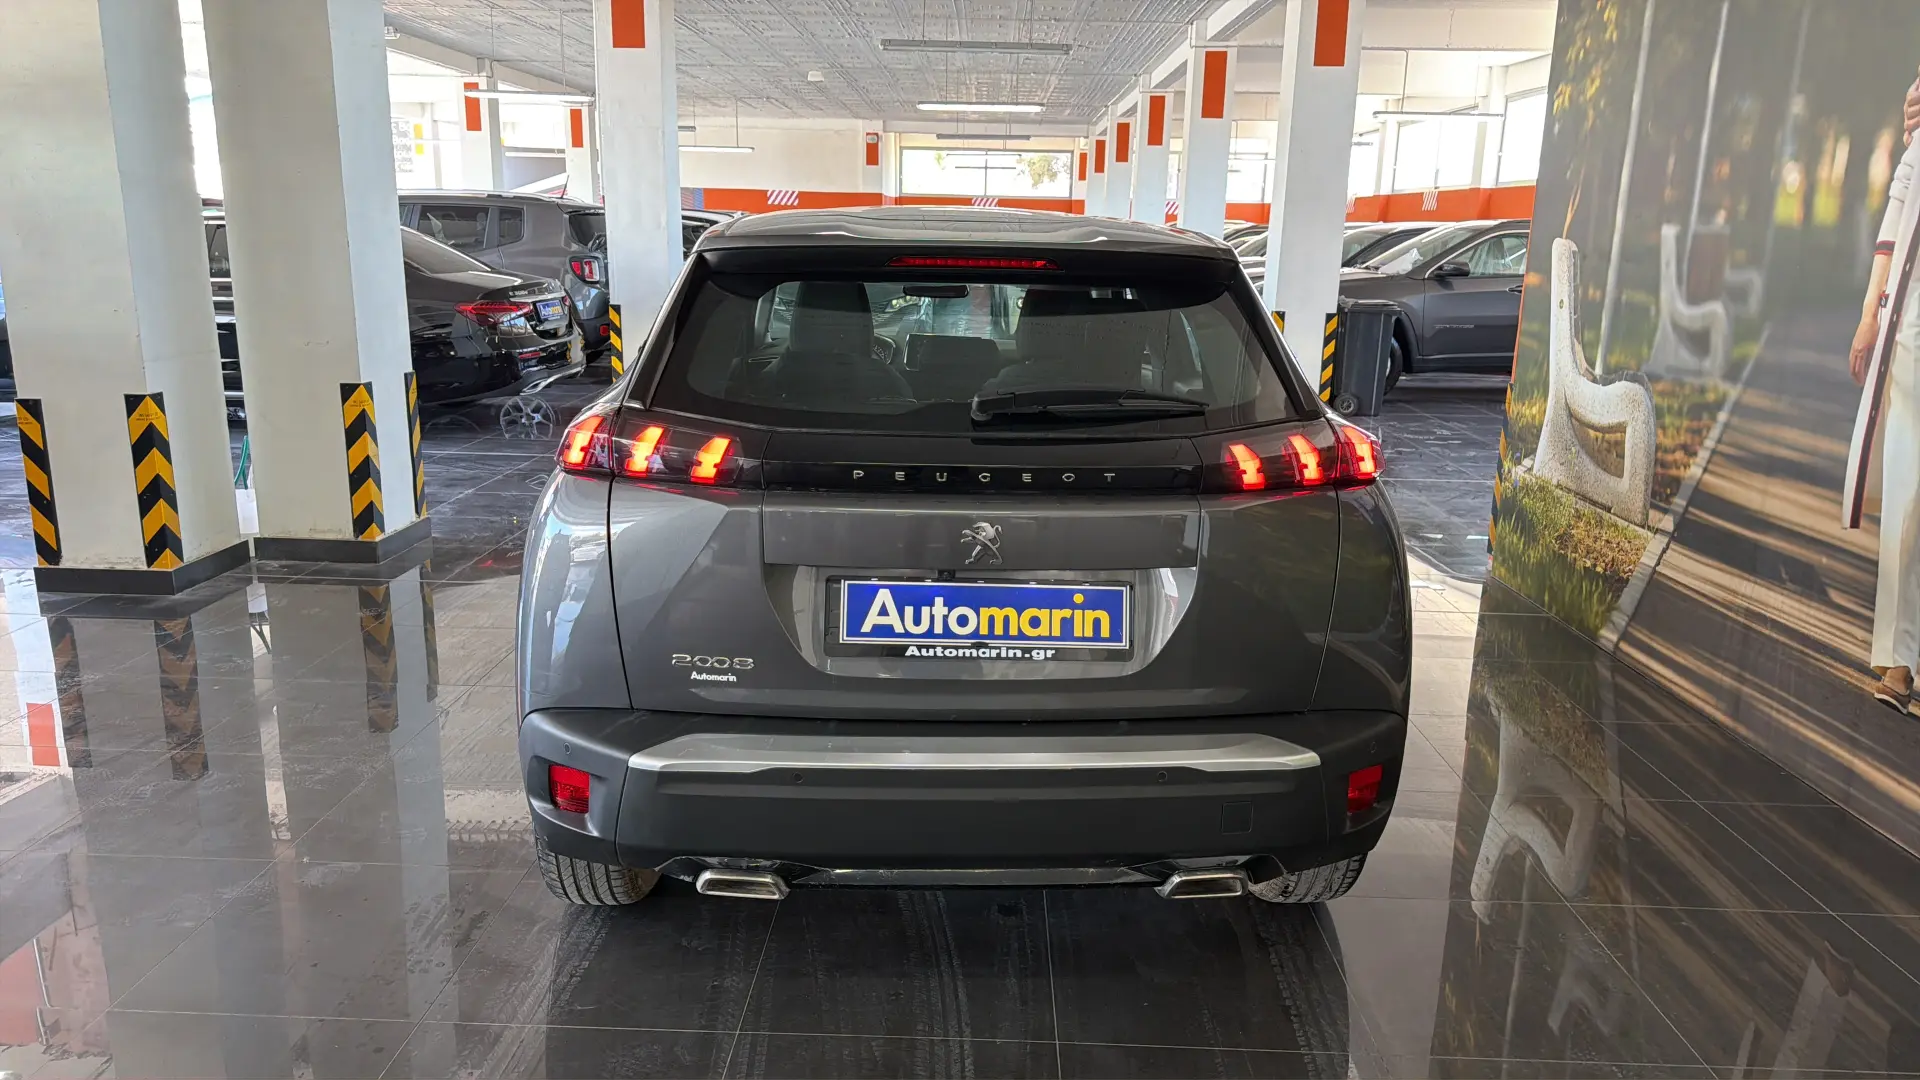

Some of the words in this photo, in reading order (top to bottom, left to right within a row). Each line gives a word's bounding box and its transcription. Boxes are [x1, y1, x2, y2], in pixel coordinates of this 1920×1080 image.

[852, 470, 1116, 483] PEUGEOT
[860, 588, 1110, 638] Automarin
[904, 645, 1056, 660] Automarin.gr
[671, 653, 755, 670] 2008
[690, 670, 737, 682] Automarin
